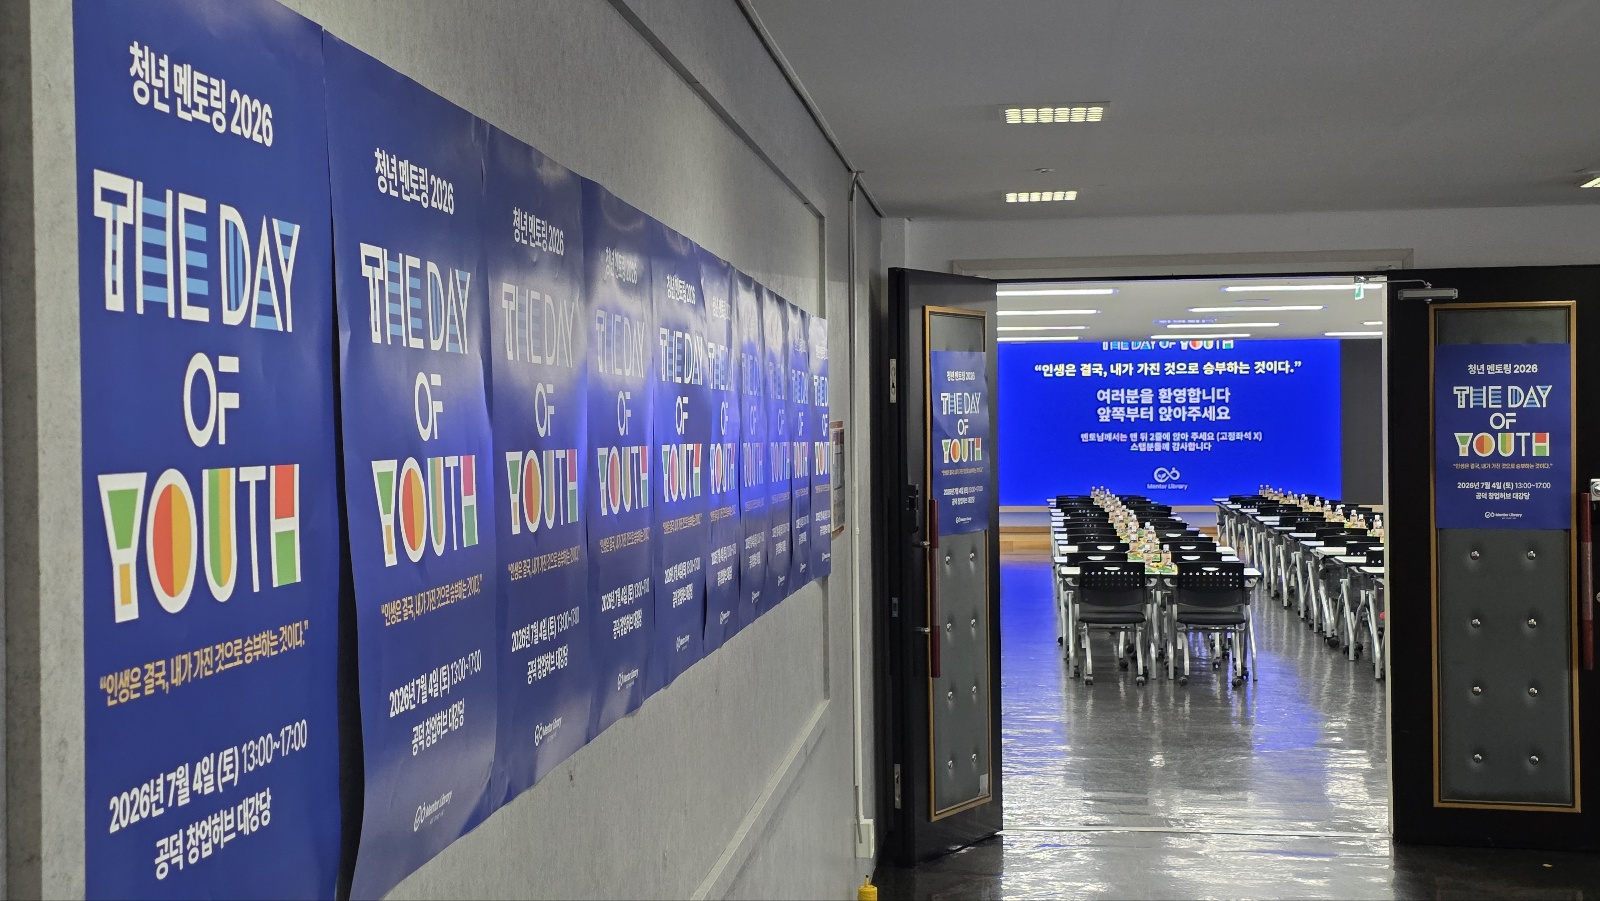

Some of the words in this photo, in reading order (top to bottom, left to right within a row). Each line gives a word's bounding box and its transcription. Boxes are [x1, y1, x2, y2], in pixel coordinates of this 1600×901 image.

[129, 41, 170, 114] 청년
[173, 63, 227, 134] 멘토링
[230, 89, 273, 147] 2026
[374, 147, 399, 198] 청년
[399, 159, 429, 209] 멘토링
[430, 174, 455, 215] 2026
[93, 168, 209, 322] THE
[219, 203, 300, 332] DAY
[512, 206, 528, 245] 청년
[528, 214, 548, 252] 멘토링
[548, 224, 564, 256] 2026
[359, 242, 424, 349] THE
[426, 260, 471, 355] DAY
[502, 282, 542, 364] THE
[544, 293, 575, 368] DAY
[595, 309, 623, 376] THE
[623, 316, 645, 378] DAY
[659, 327, 682, 384] THE
[684, 332, 703, 386] DAY
[1034, 363, 1076, 377] “인생은
[1080, 363, 1108, 378] 결국,
[1110, 362, 1134, 376] 내가
[1136, 362, 1160, 376] 가진
[1164, 361, 1199, 376] 것으로
[1203, 361, 1250, 375] 승부하는
[1467, 363, 1485, 375] 청년
[1486, 363, 1512, 375] 멘토링
[1513, 363, 1538, 374] 2026
[183, 352, 240, 447] OF
[414, 371, 443, 442] OF
[534, 382, 555, 438] OF
[617, 390, 632, 437] OF
[675, 395, 689, 436] OF
[940, 392, 963, 415] THE
[963, 391, 981, 415] DAY
[1096, 387, 1154, 405] 여러분을
[1158, 386, 1231, 404] 환영합니다
[1097, 405, 1154, 422] 앞쪽부터
[1158, 405, 1231, 422] 앉아주세요
[1453, 385, 1502, 409] THE
[1507, 384, 1553, 409] DAY
[1489, 412, 1517, 430] OF
[941, 437, 982, 464] YOUTH
[957, 418, 969, 436] OF
[1080, 432, 1128, 442] 멘토님께서는
[1149, 432, 1171, 441] 2줄에
[1172, 431, 1189, 441] 앉아
[1190, 431, 1215, 441] 주세요
[1171, 441, 1212, 452] 감사합니다
[1454, 432, 1550, 457] YOUTH
[505, 448, 579, 535] YOUTH
[596, 445, 650, 516] YOUTH
[661, 443, 702, 502] YOUTH
[709, 442, 736, 495] YOUTH
[1167, 483, 1188, 491] Library
[1457, 481, 1480, 490] 2026년
[1480, 481, 1491, 490] 7월
[1491, 481, 1502, 490] 4일
[1502, 481, 1514, 491] (토)
[371, 454, 479, 567] YOUTH
[97, 463, 301, 623] YOUTH
[415, 591, 426, 616] 내가
[426, 588, 437, 612] 가진
[436, 584, 450, 609] 것으로
[531, 620, 539, 645] 7월
[548, 615, 557, 641] (토)
[144, 659, 169, 694] 결국,
[170, 651, 192, 686] 내가
[193, 645, 213, 679] 가진
[215, 638, 243, 673] 것으로
[244, 629, 278, 664] 승부하는
[389, 678, 416, 718] 2026년
[416, 672, 427, 705] 7월
[428, 667, 439, 698] 4일
[440, 664, 450, 698] (토)
[411, 720, 425, 756] 공덕
[425, 709, 448, 748] 창업허브
[448, 697, 465, 732] 대강당
[109, 772, 164, 834] 2026년
[167, 762, 190, 808] 7월
[192, 752, 214, 796] 4일
[217, 745, 239, 793] (토)
[241, 718, 308, 774] 13:00~17:00
[154, 828, 184, 880] 공덕
[186, 806, 236, 864] 창업허브
[237, 787, 272, 836] 대강당
